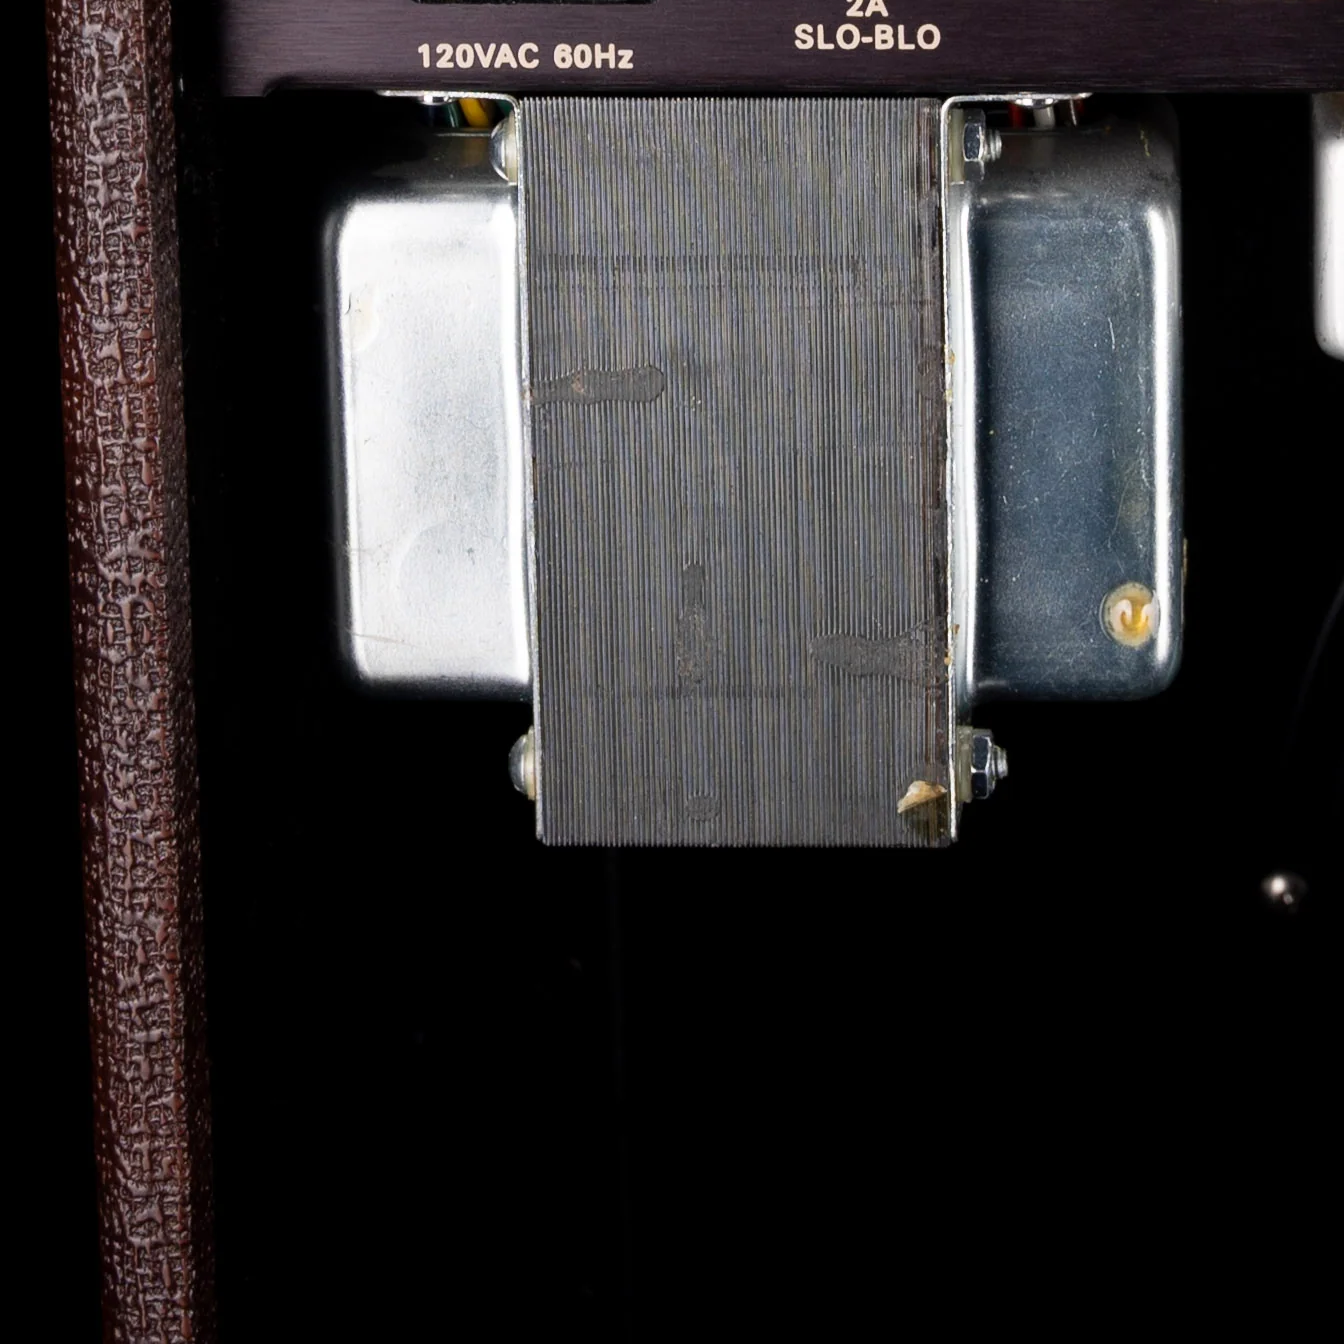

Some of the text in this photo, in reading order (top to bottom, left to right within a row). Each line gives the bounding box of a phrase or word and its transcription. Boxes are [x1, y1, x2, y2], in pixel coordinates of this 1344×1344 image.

[794, 23, 942, 51] SLO-BLO
[417, 42, 634, 70] 120VAC 60Hz
